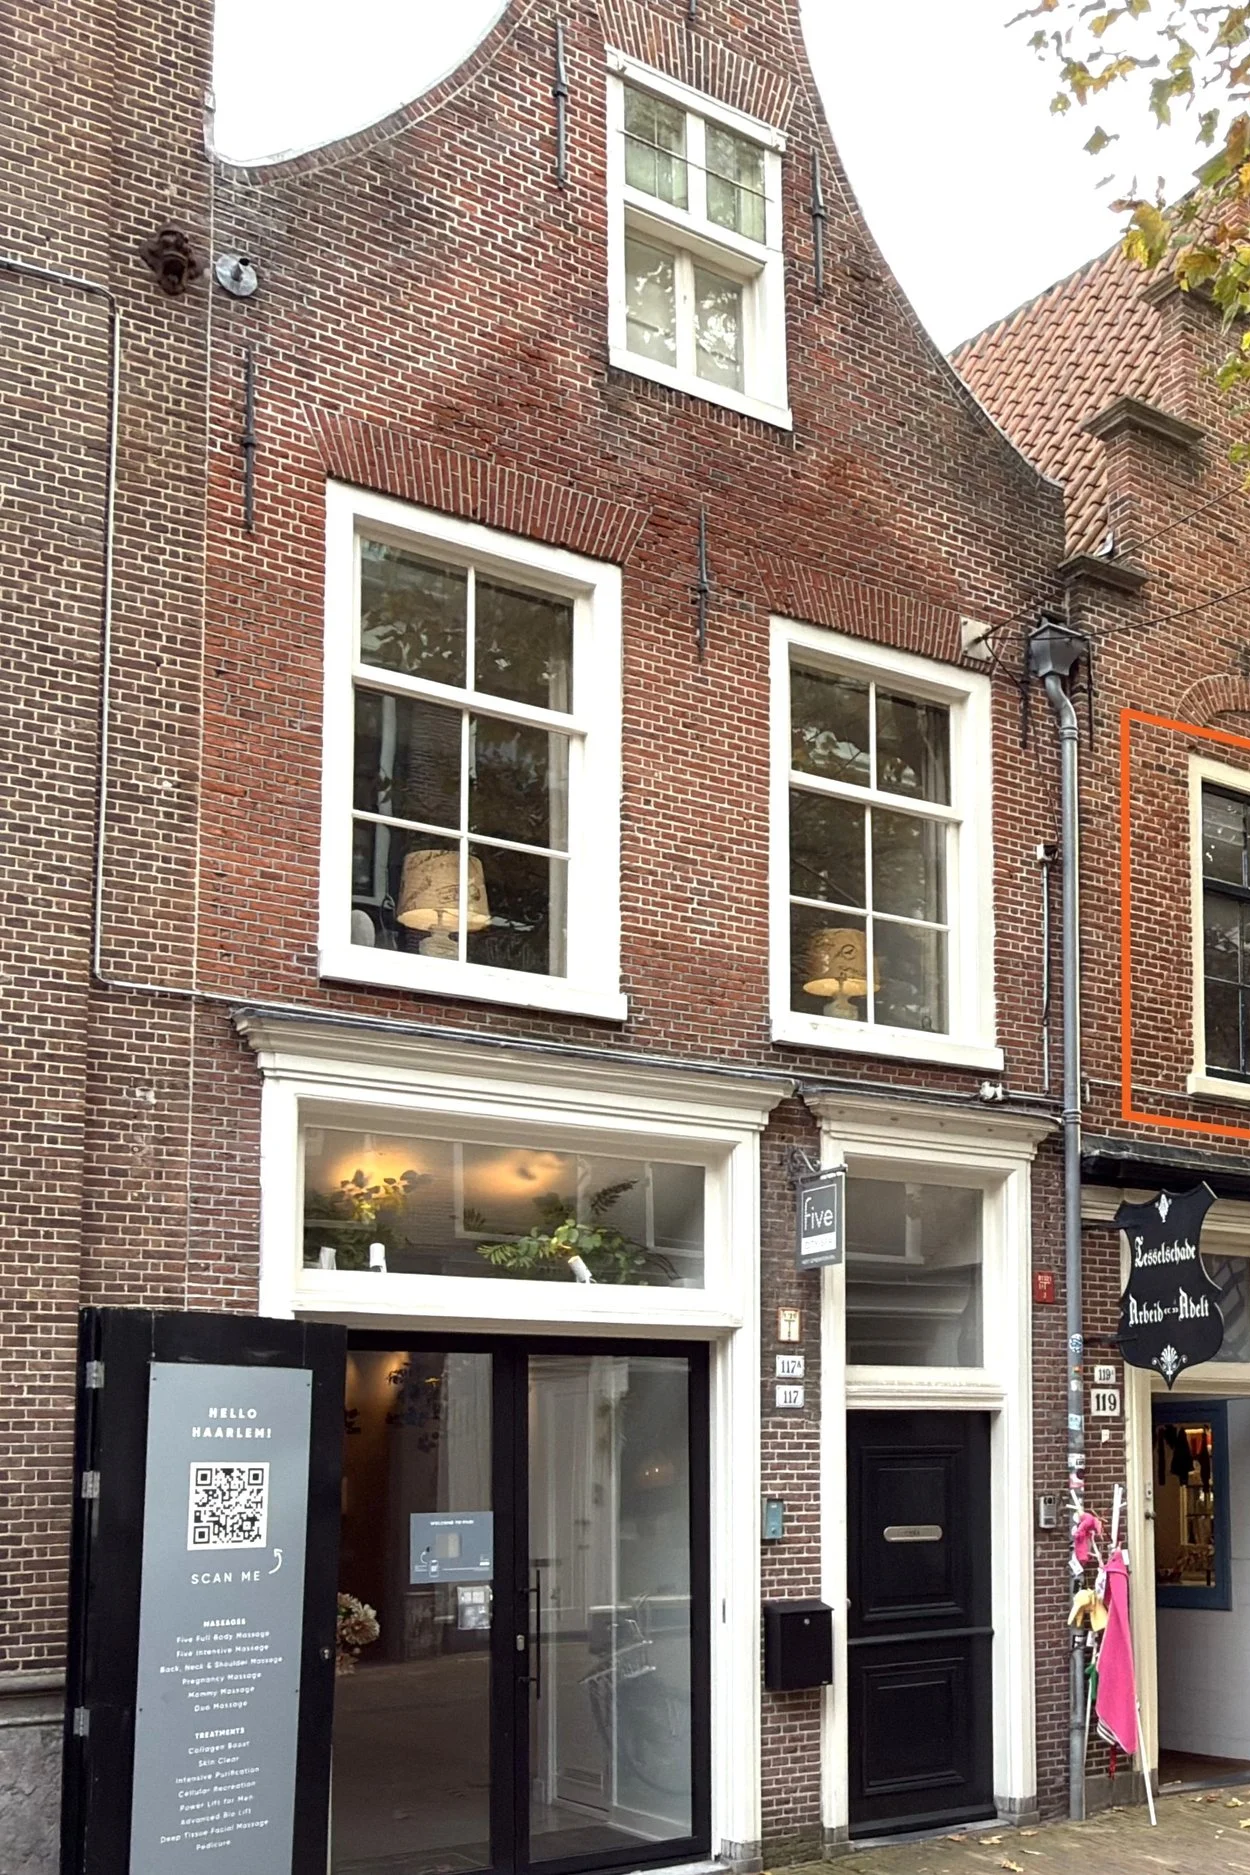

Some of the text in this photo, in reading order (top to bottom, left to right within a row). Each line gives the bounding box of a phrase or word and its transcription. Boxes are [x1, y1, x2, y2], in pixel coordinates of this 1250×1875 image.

[804, 1197, 834, 1231] five
[1134, 1235, 1196, 1268] Tesselschade
[1129, 1286, 1209, 1327] Arbeid Adelt
[781, 1360, 802, 1373] 117A
[783, 1391, 799, 1404] 117
[1095, 1393, 1117, 1412] 119
[208, 1407, 258, 1420] HELLO
[192, 1427, 272, 1439] HAARLEM!
[191, 1570, 261, 1585] SCAN ME
[203, 1618, 246, 1627] MASSAGES
[213, 1633, 232, 1641] Body
[236, 1631, 269, 1639] Massage
[214, 1660, 247, 1668] Shoulder
[182, 1672, 261, 1685] Pregnancy Massage
[220, 1686, 254, 1694] Massage
[194, 1701, 247, 1712] Duo Massage
[195, 1727, 245, 1739] TREATMENTS
[188, 1741, 250, 1754] Collagen Boost
[198, 1756, 239, 1767] Skin Clear
[175, 1774, 212, 1783] Intensive
[178, 1781, 255, 1798] Cellular Recreation
[179, 1803, 204, 1811] Power
[180, 1814, 220, 1825] Advanced
[160, 1820, 269, 1844] Deep Tissue Facial Massage
[196, 1840, 231, 1851] Pedicure
